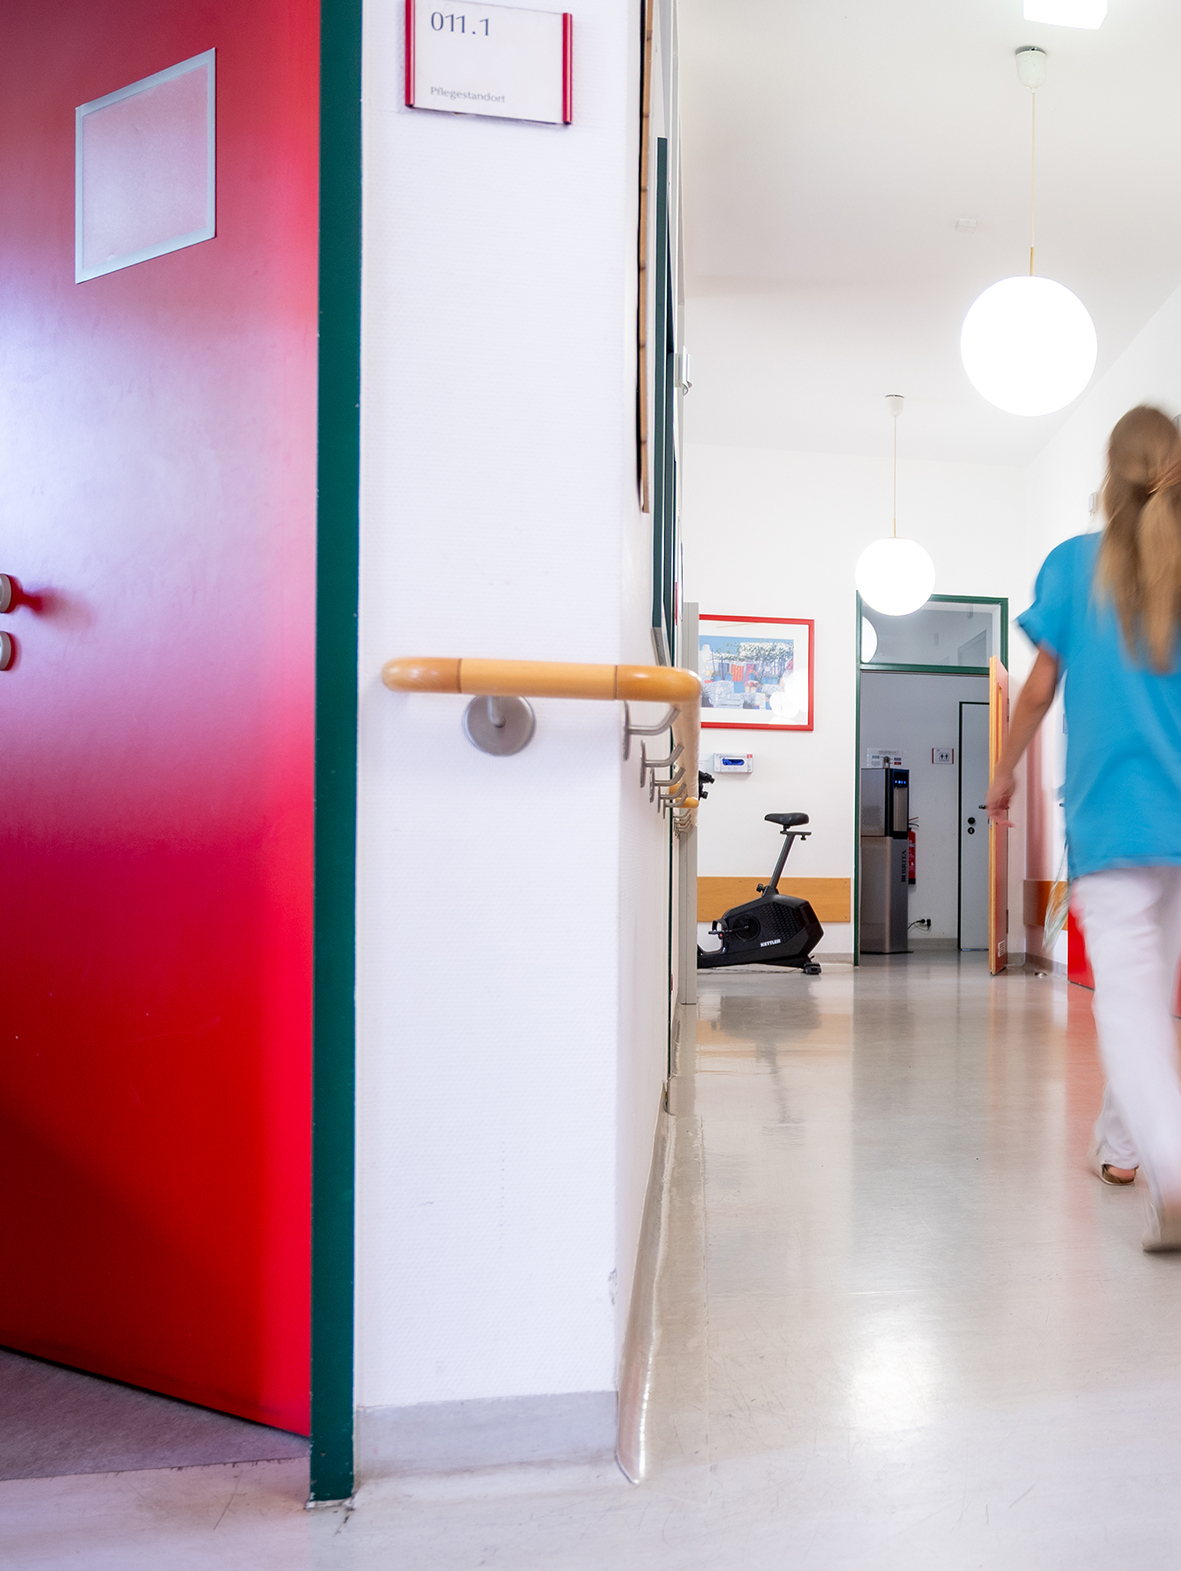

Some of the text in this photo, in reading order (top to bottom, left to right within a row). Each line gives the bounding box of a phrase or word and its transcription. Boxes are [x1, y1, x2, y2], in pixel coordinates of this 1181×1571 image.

[431, 11, 490, 36] 011.1
[430, 86, 506, 104] Pflegestandort
[760, 938, 781, 948] KETTLER
